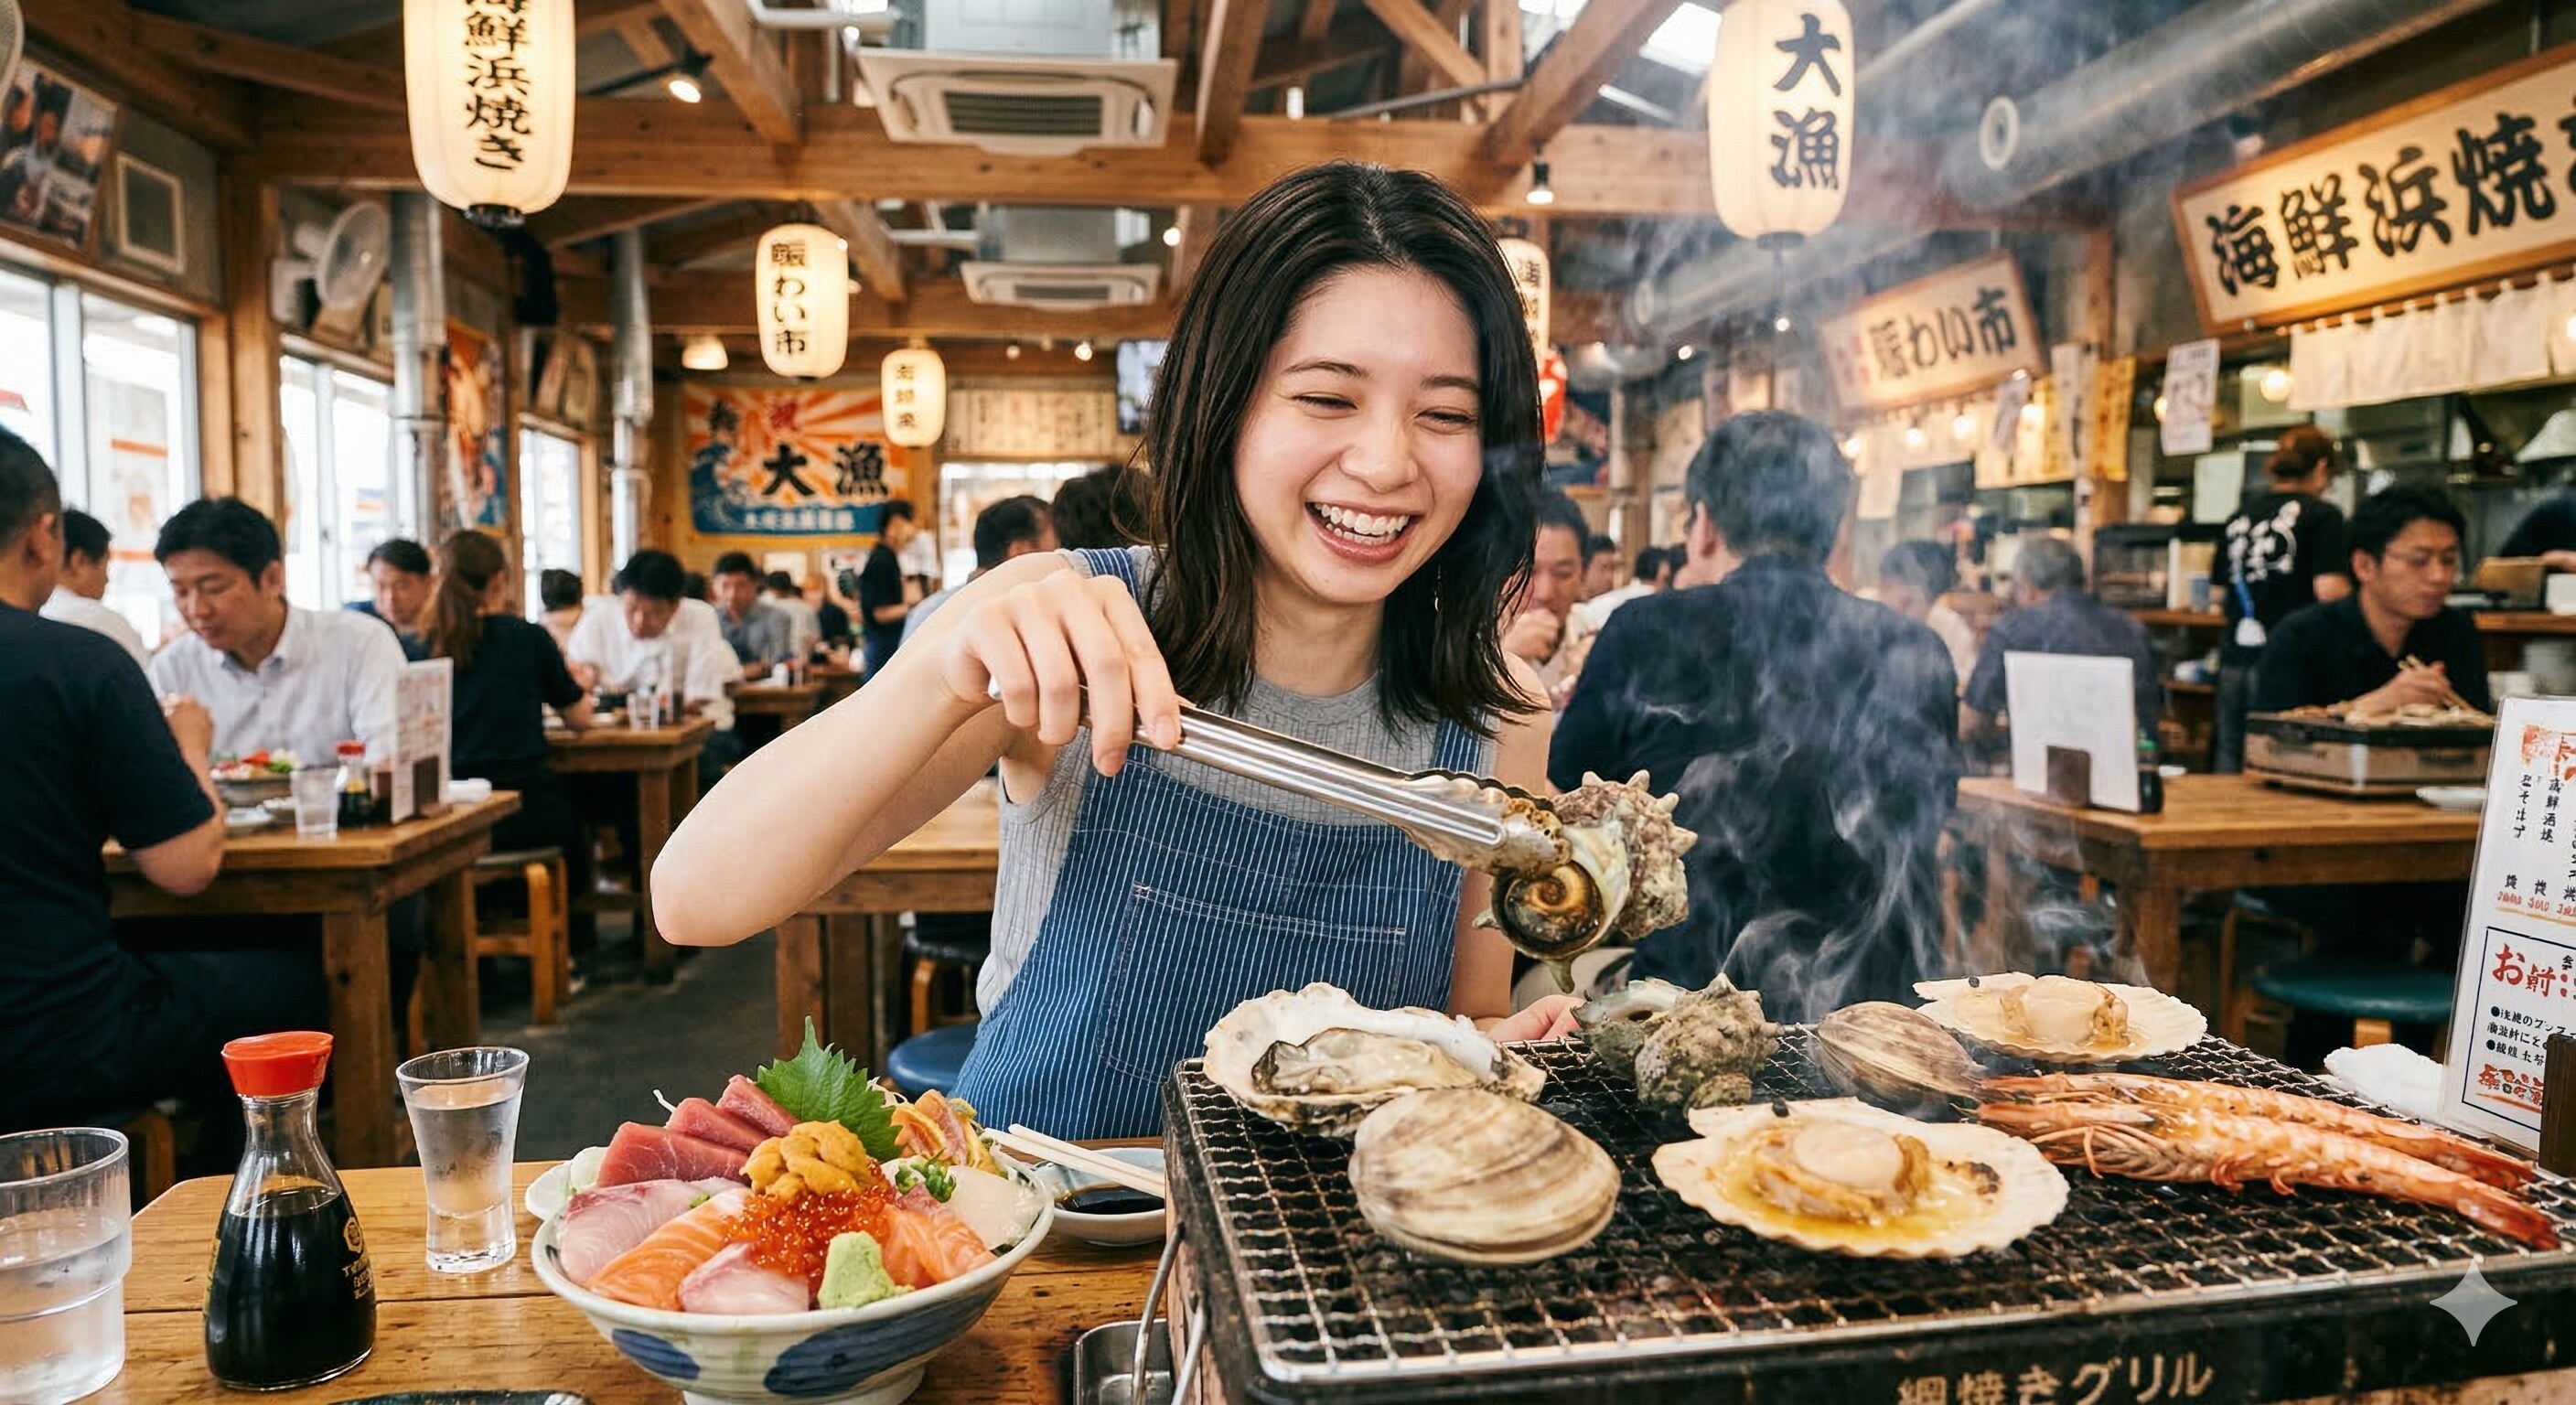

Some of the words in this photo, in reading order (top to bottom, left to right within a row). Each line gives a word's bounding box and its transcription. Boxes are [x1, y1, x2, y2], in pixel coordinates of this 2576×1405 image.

[465, 0, 531, 171] 鮮浜焼き
[1770, 13, 1841, 190] 大漁
[761, 444, 889, 497] 大漁
